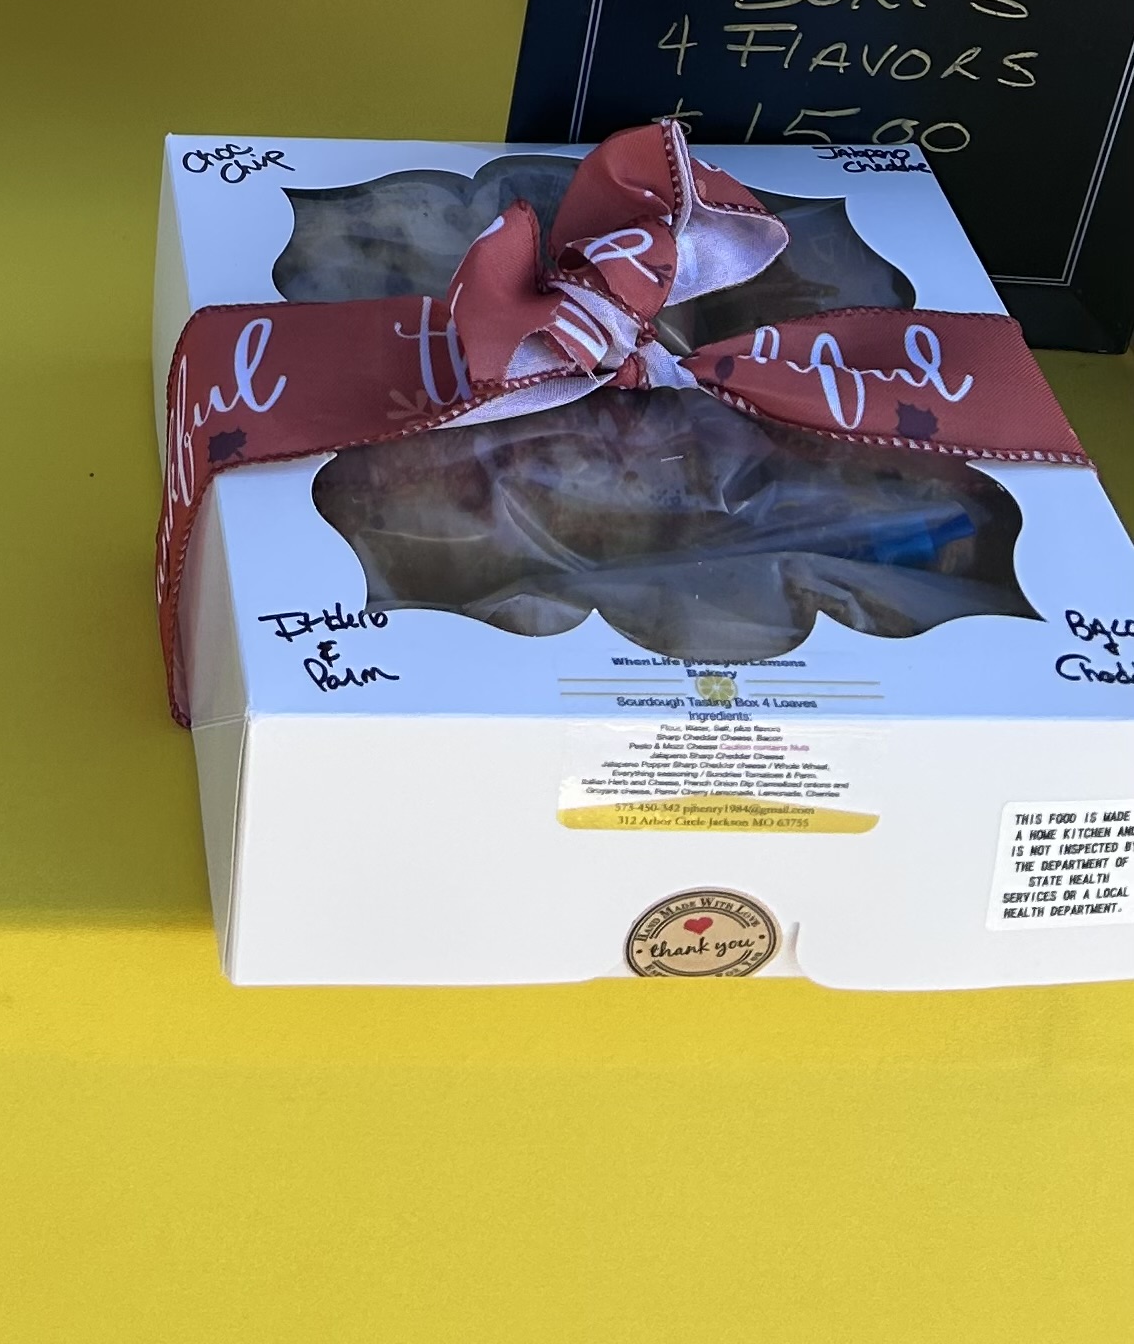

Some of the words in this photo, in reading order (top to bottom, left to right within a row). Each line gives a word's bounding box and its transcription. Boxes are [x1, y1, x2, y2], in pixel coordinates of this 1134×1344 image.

[658, 14, 698, 76] 4
[611, 657, 651, 666] When
[652, 656, 681, 666] Life
[686, 668, 738, 680] Bakery
[616, 696, 685, 709] Sourdough
[687, 696, 733, 709] Tasting
[735, 697, 759, 708] Box
[762, 698, 770, 708] 4
[773, 698, 818, 708] Loaves
[688, 710, 753, 723] Ingredients:
[617, 816, 637, 826] 312
[639, 816, 672, 826] Arbor
[675, 816, 707, 827] Circle
[707, 817, 750, 829] Jackson
[752, 818, 775, 827] MO
[649, 936, 711, 958] thank
[714, 938, 756, 958] you
